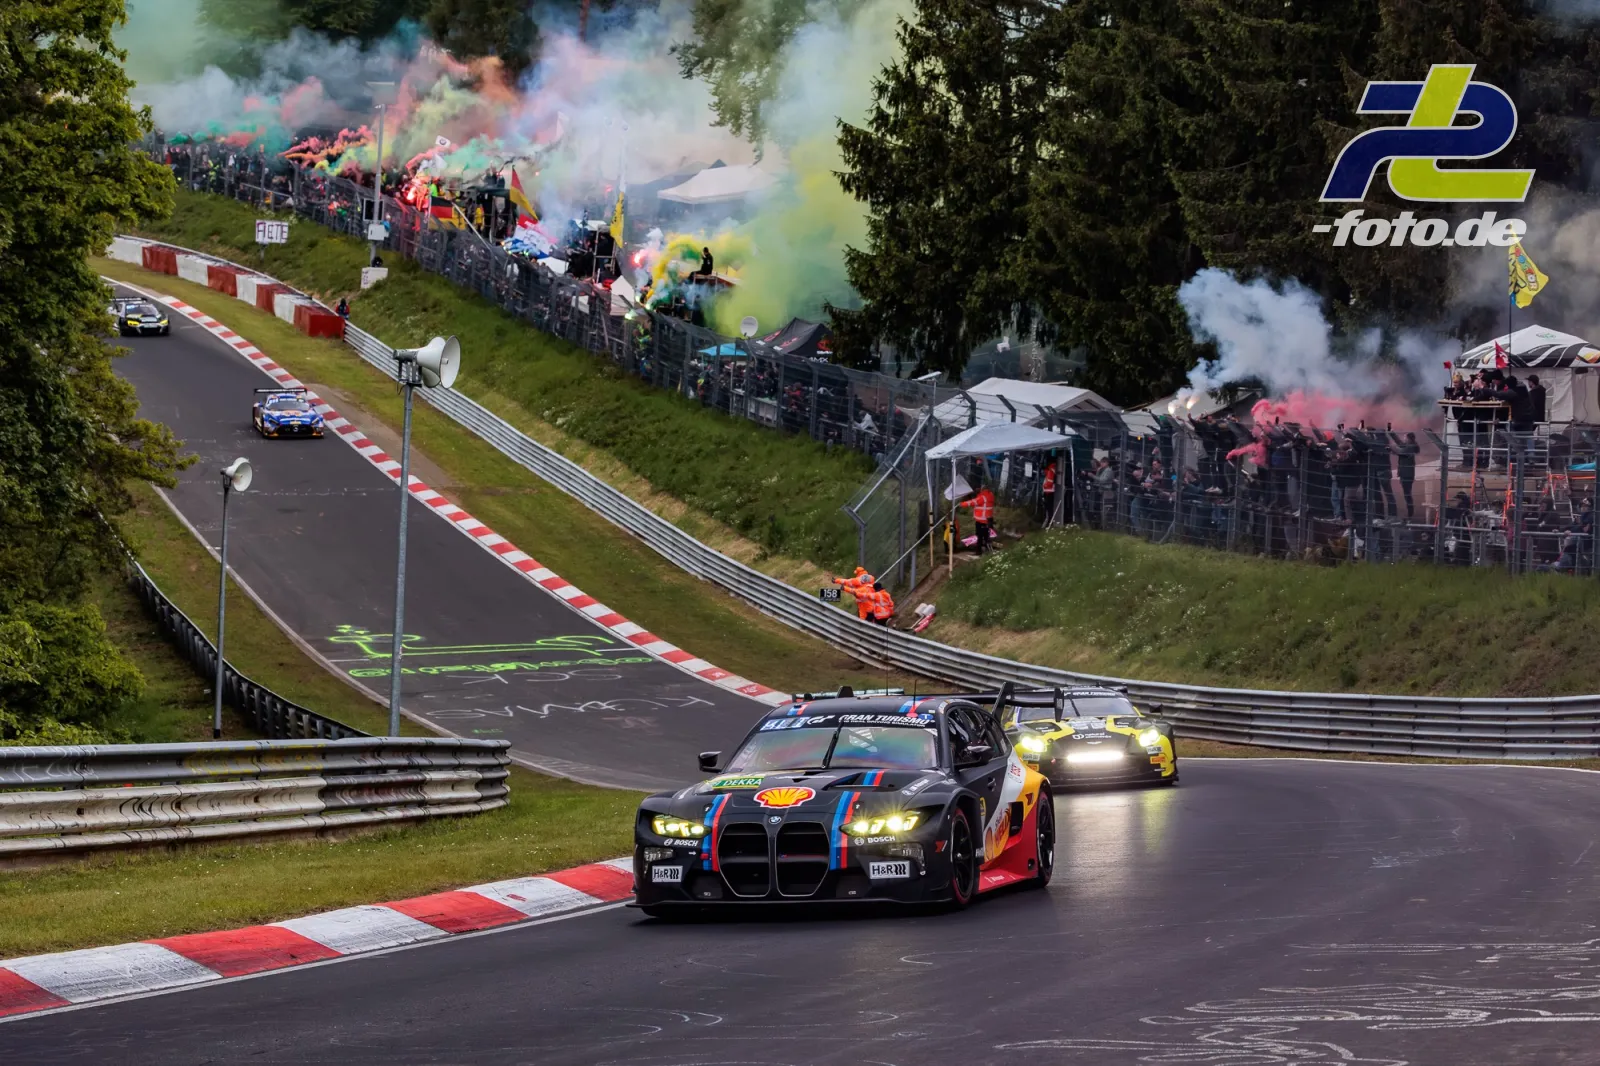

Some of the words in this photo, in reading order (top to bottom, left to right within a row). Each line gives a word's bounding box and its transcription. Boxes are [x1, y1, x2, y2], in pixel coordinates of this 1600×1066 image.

[823, 589, 838, 598] 158
[723, 778, 761, 786] DEKRA
[674, 839, 699, 847] BOSCH
[867, 836, 896, 844] BOSCH
[872, 864, 893, 875] H&R
